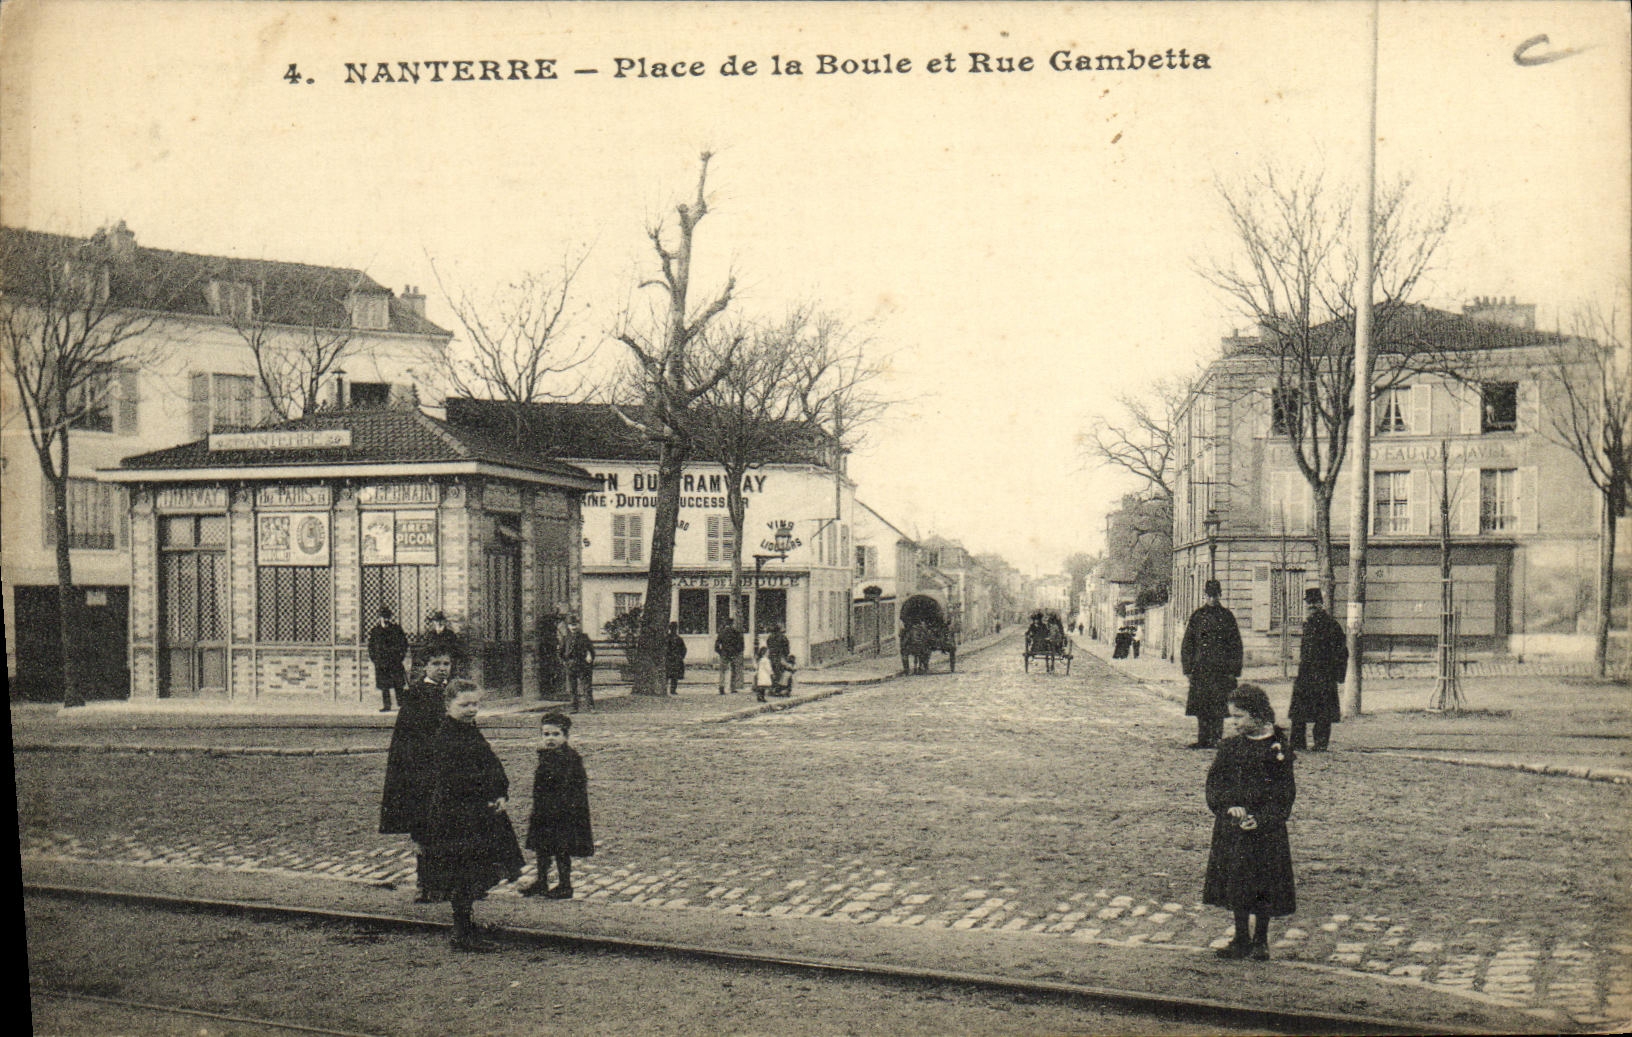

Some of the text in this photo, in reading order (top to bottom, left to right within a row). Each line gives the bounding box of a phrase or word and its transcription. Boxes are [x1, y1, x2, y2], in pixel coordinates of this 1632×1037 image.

[633, 473, 658, 491] DU
[681, 474, 767, 493] RAMAY
[615, 493, 658, 508] DUTOU
[679, 496, 749, 508] UCCESSR
[396, 532, 435, 546] PICON
